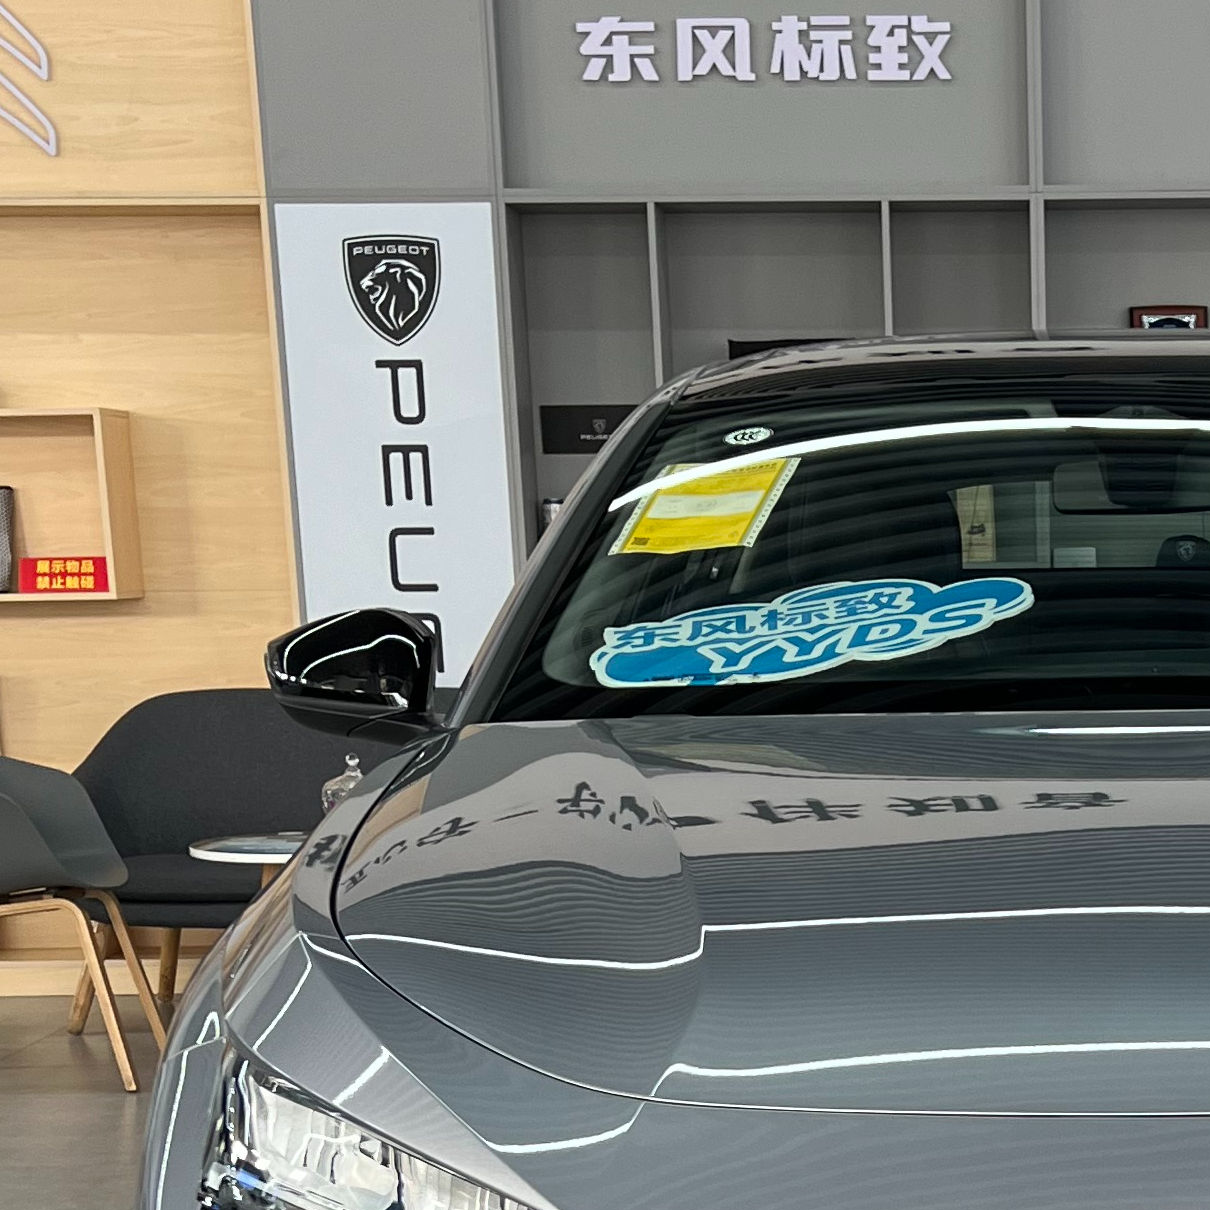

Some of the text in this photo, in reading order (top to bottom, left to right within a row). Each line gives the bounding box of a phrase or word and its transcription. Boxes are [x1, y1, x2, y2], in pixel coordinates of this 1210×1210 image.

[575, 14, 953, 82] 东风标致
[353, 245, 430, 255] PEUGEOT
[36, 559, 95, 574] 展示物品
[613, 590, 912, 649] 东风标致
[700, 598, 997, 672] YYDS
